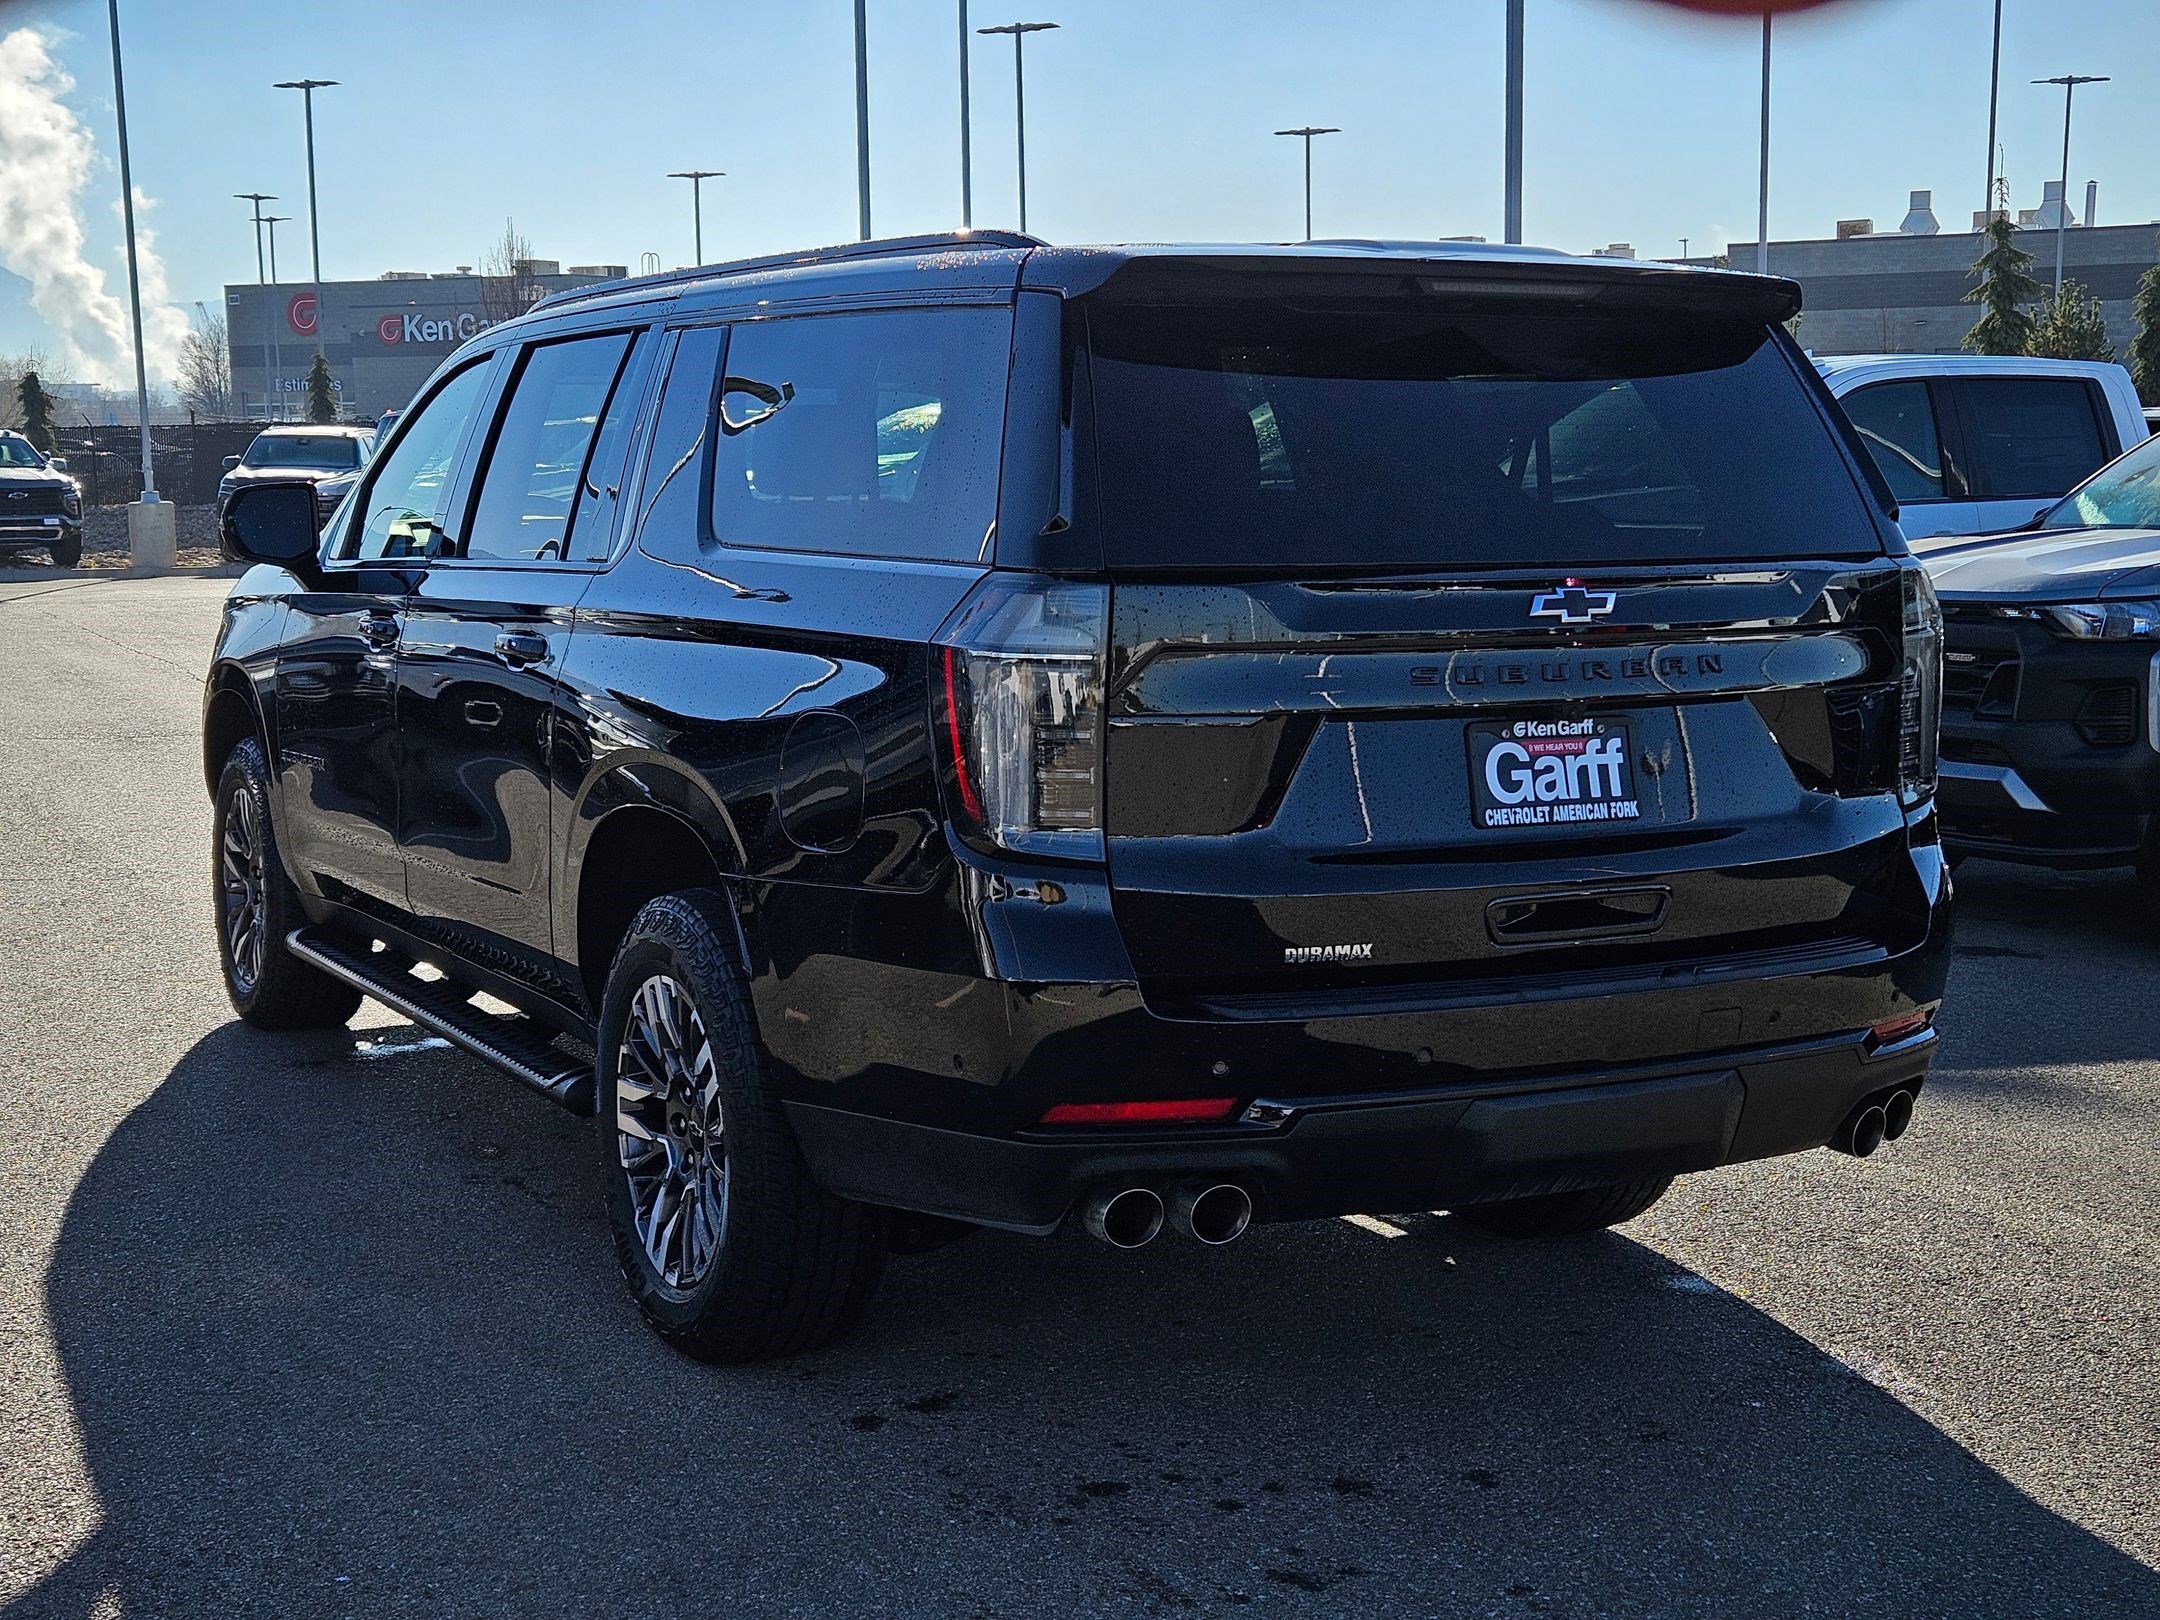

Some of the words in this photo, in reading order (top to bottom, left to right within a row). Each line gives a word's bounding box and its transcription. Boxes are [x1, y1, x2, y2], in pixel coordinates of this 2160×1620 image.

[404, 314, 453, 342] Ken
[1410, 654, 1724, 685] SUBURBAN
[1527, 721, 1556, 737] Ken
[1557, 719, 1593, 736] Garff
[1545, 743, 1564, 751] HEAR
[1485, 737, 1623, 804] Garff
[1485, 806, 1550, 826] CHEVROLET
[1553, 803, 1608, 822] AMERICAN
[1610, 800, 1639, 818] FORK
[1284, 943, 1373, 963] DURAMAX
